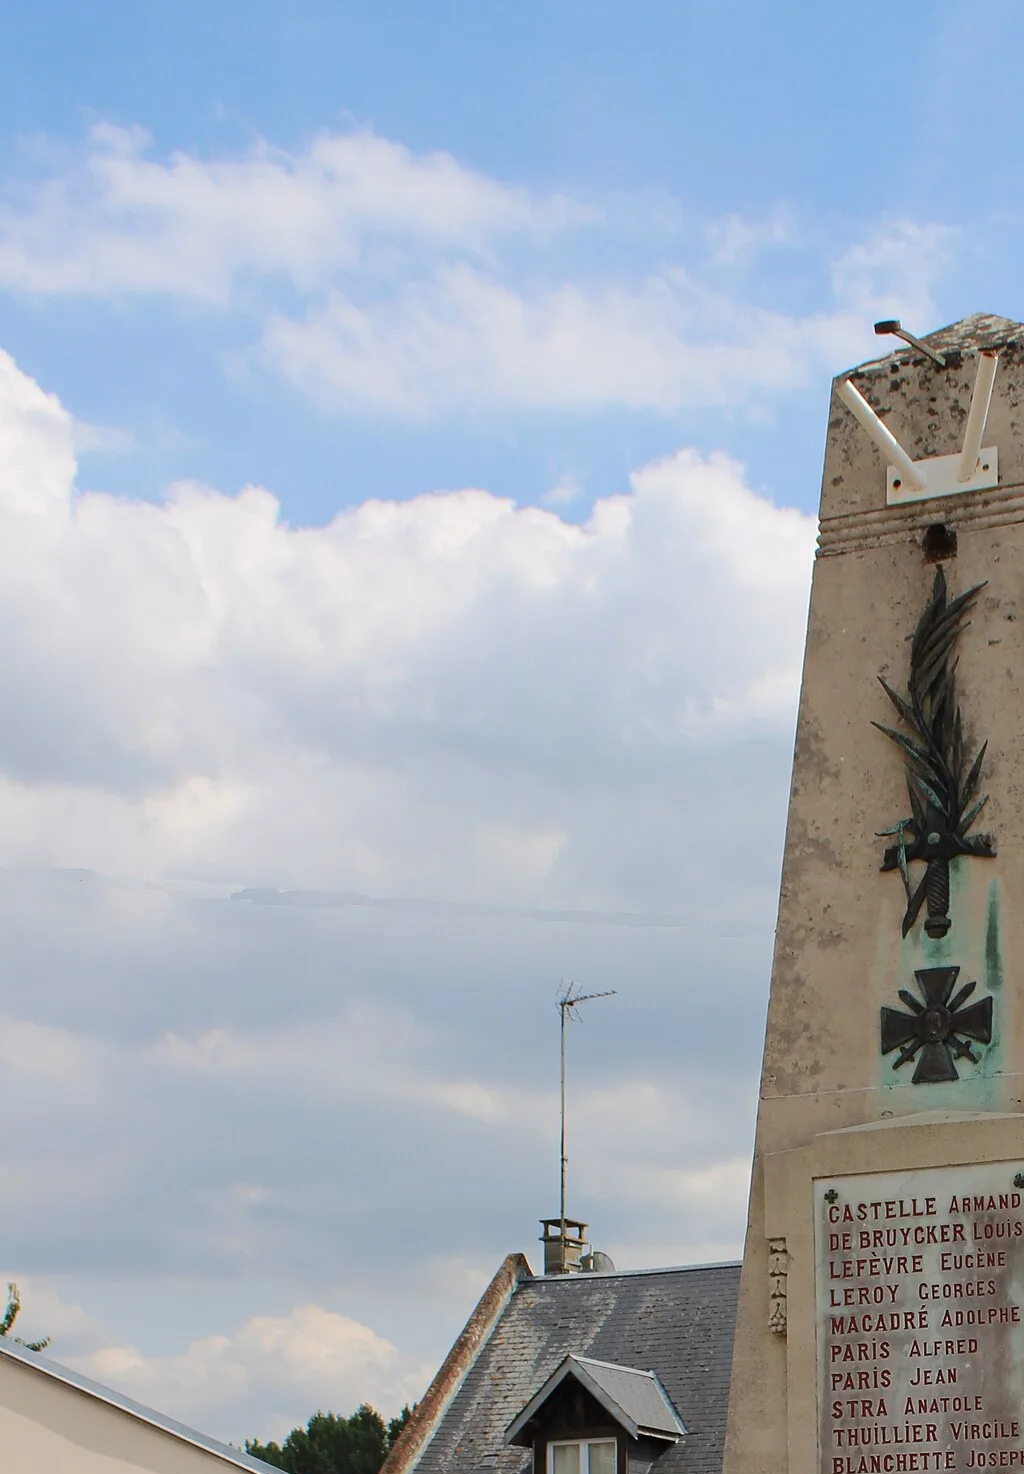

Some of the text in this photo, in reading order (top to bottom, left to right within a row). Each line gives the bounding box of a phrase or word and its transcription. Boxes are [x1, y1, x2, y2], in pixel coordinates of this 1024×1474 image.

[829, 1193, 1021, 1223] CASTELLE ARMAND
[830, 1219, 1023, 1251] DE BRUYCKER LOUIS
[829, 1249, 1006, 1279] LEFÈVRE EUGÈNE
[830, 1280, 996, 1307] LEROY GEORGES
[831, 1305, 1021, 1335] MACADRÉ ADOLPHE
[831, 1338, 978, 1362] PARIS ALFRED
[831, 1367, 957, 1391] PARIS JEAN
[831, 1396, 983, 1419] STRA ANATOLE
[833, 1419, 1020, 1447] THUILLIER VIRGILE
